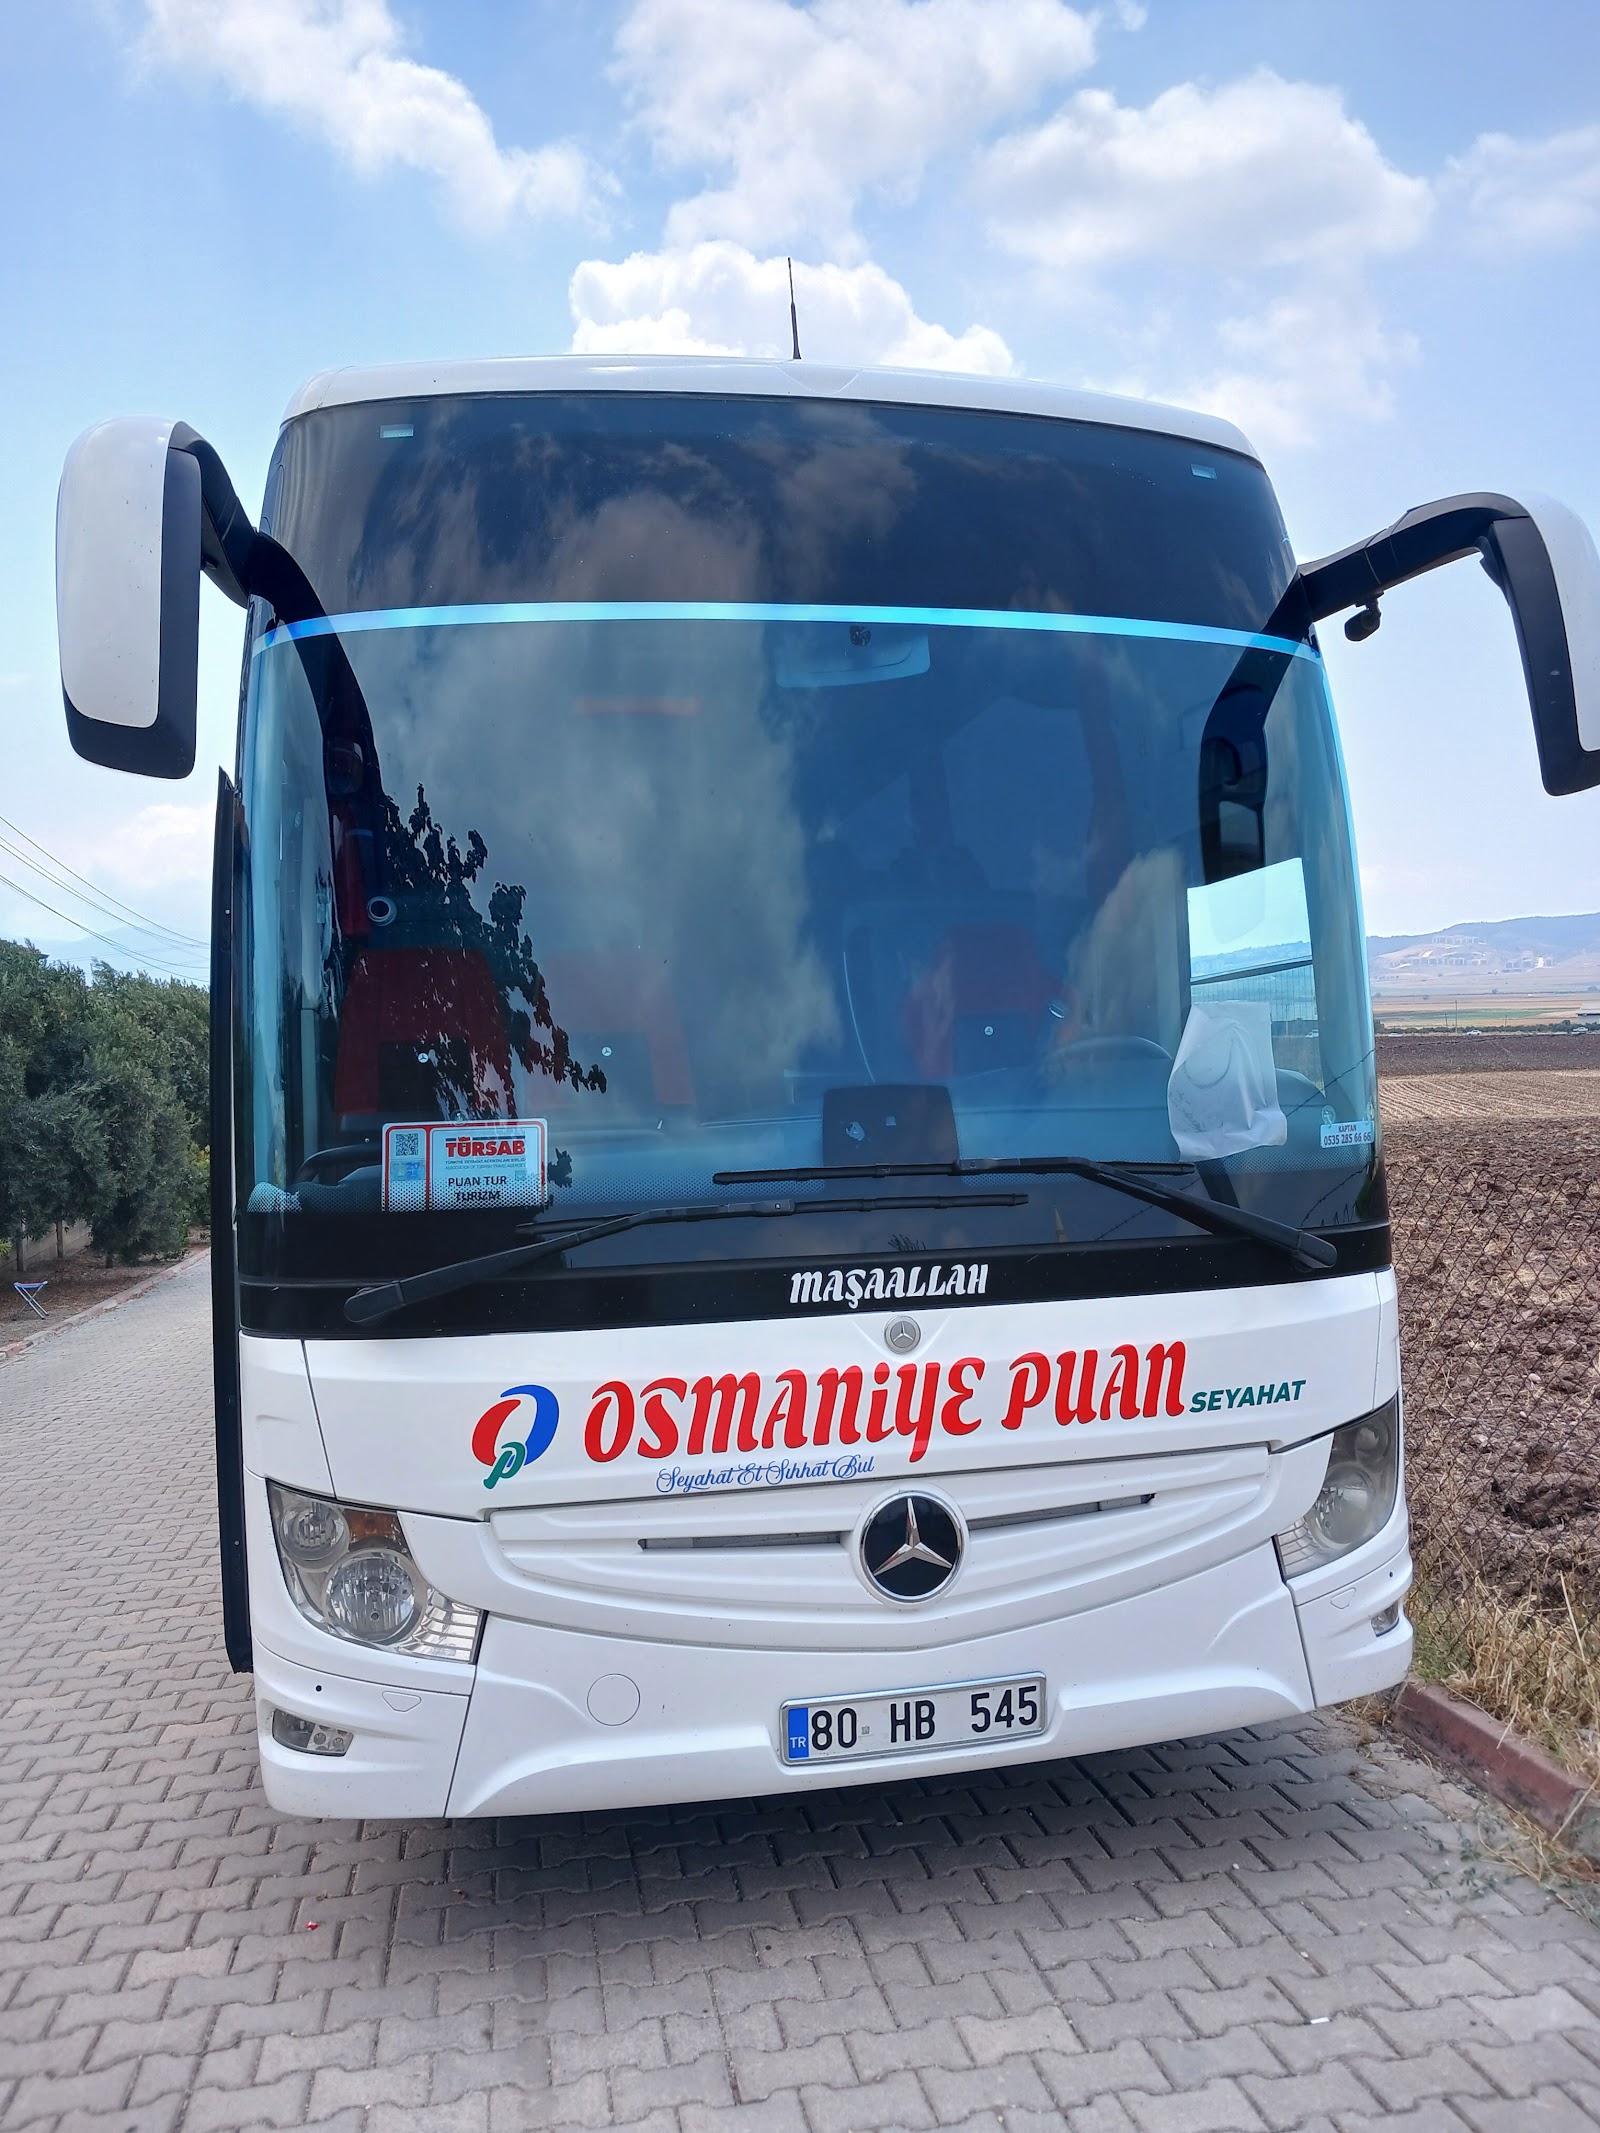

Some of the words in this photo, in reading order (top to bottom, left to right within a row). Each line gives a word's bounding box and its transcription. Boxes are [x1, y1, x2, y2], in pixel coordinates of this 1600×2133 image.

[445, 1136, 526, 1158] TÜRSAB
[1324, 1135, 1339, 1145] 0535
[1341, 1134, 1352, 1144] 285
[1354, 1133, 1361, 1142] 66
[448, 1176, 480, 1187] PUAN
[483, 1175, 507, 1186] TUR
[790, 1263, 989, 1309] MAŞAALLAH
[1000, 1340, 1186, 1431] PUAN
[1189, 1379, 1307, 1414] SEYAHAT
[656, 1466, 735, 1493] Seyahat
[736, 1462, 763, 1486] Et
[832, 1454, 875, 1479] Bul
[811, 1707, 858, 1751] 80
[890, 1699, 936, 1743] HB
[970, 1685, 1038, 1733] 545
[789, 1735, 807, 1749] TR
